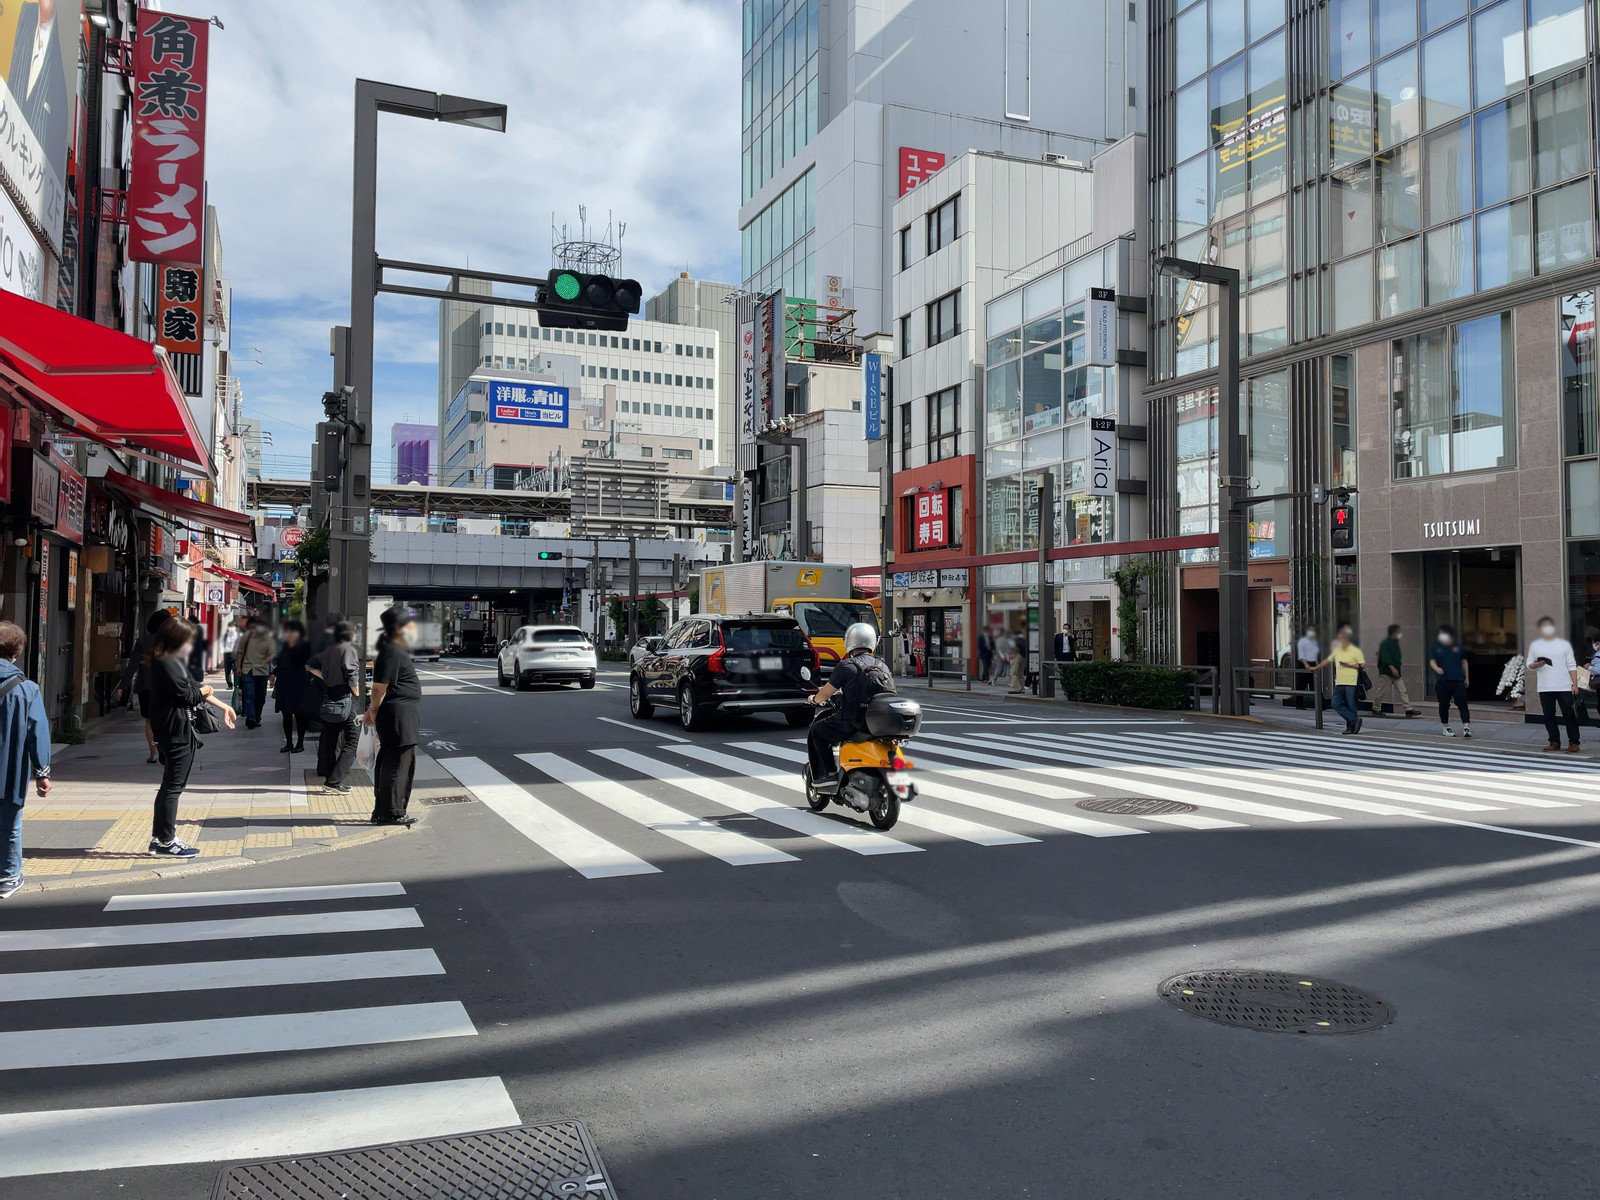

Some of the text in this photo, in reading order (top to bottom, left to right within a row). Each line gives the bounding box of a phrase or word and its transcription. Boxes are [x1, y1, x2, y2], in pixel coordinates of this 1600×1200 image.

[134, 15, 203, 256] 角煮ラーメン
[48, 177, 62, 236] 2F
[496, 386, 563, 406] 洋服の青山
[867, 360, 879, 432] WISEビル
[1094, 437, 1112, 488] Aria
[919, 494, 943, 518] 回転
[919, 520, 943, 546] 寿司
[1423, 519, 1480, 538] TSUTSUMI
